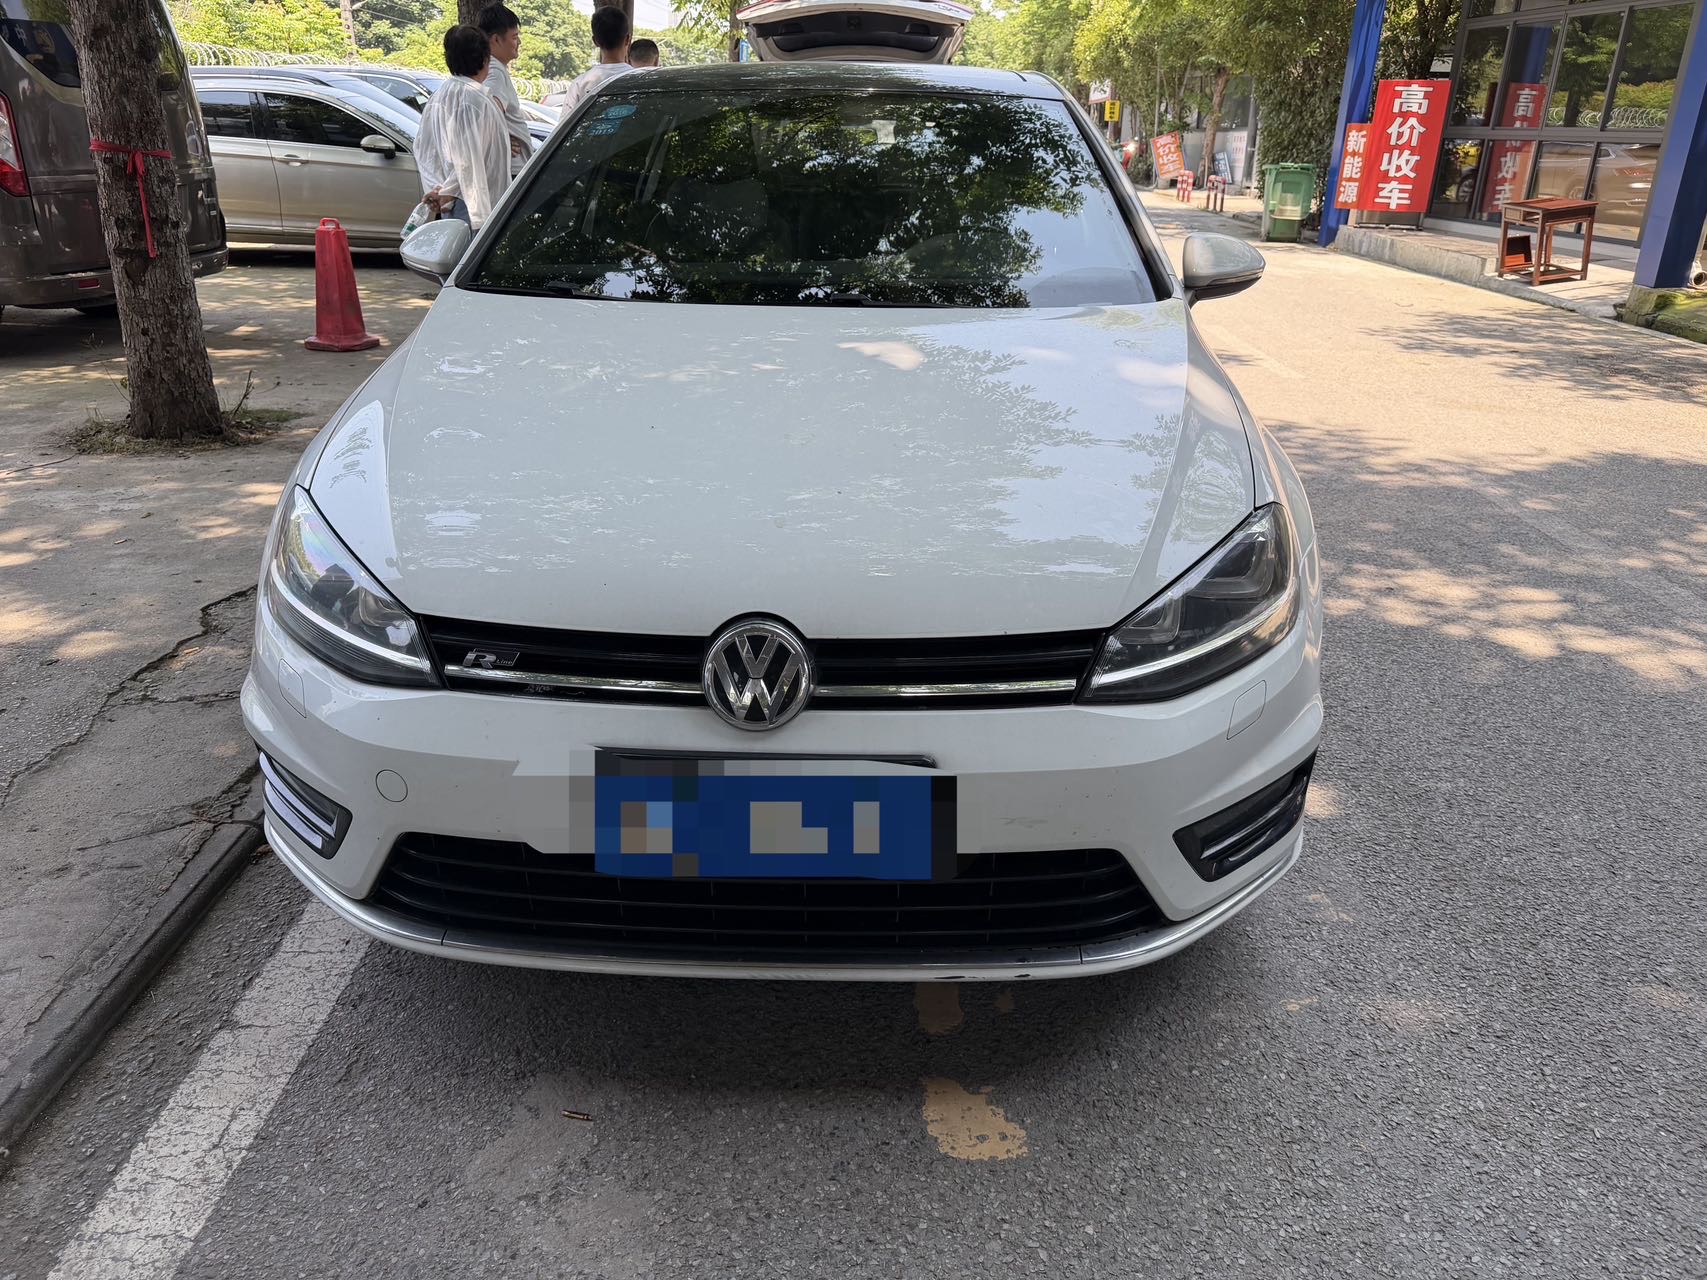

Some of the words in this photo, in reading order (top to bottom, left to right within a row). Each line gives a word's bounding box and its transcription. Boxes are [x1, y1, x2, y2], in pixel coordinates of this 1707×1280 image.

[1338, 130, 1367, 203] 新能源
[1374, 84, 1434, 210] 高价收车
